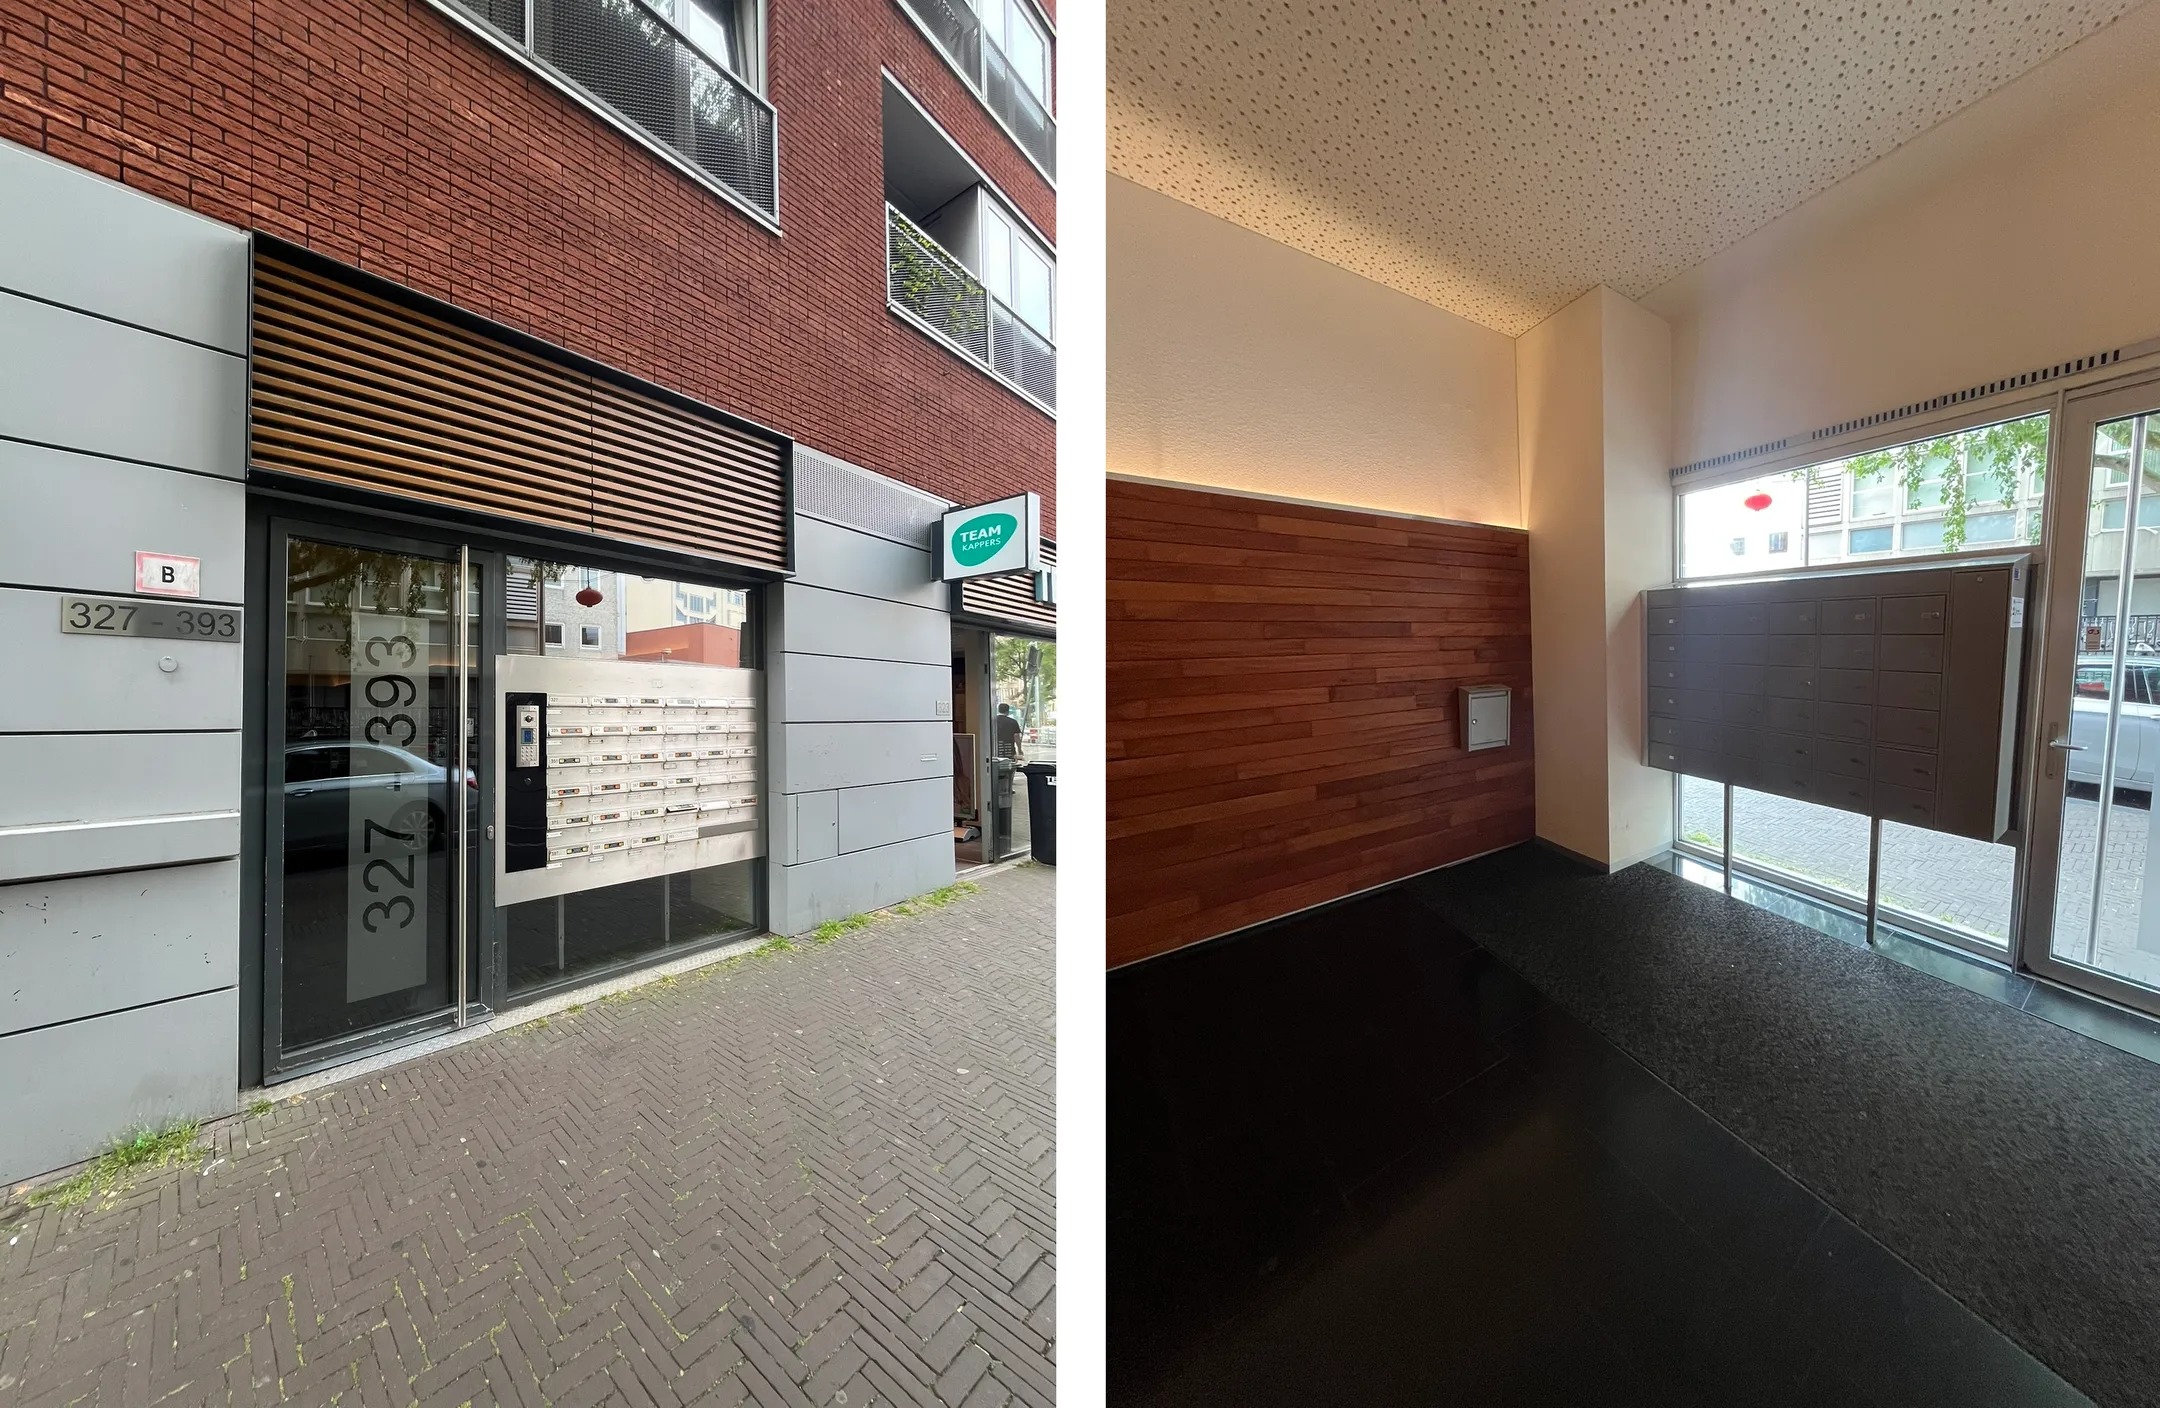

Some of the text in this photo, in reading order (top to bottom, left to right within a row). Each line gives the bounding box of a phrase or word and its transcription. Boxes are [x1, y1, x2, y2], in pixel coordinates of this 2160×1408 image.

[960, 524, 1002, 543] TEAM
[962, 537, 1002, 552] KAPPERS
[161, 565, 175, 583] B
[69, 602, 140, 631] 327
[176, 610, 236, 638] 393
[364, 635, 417, 747] 393
[362, 818, 416, 933] 327
